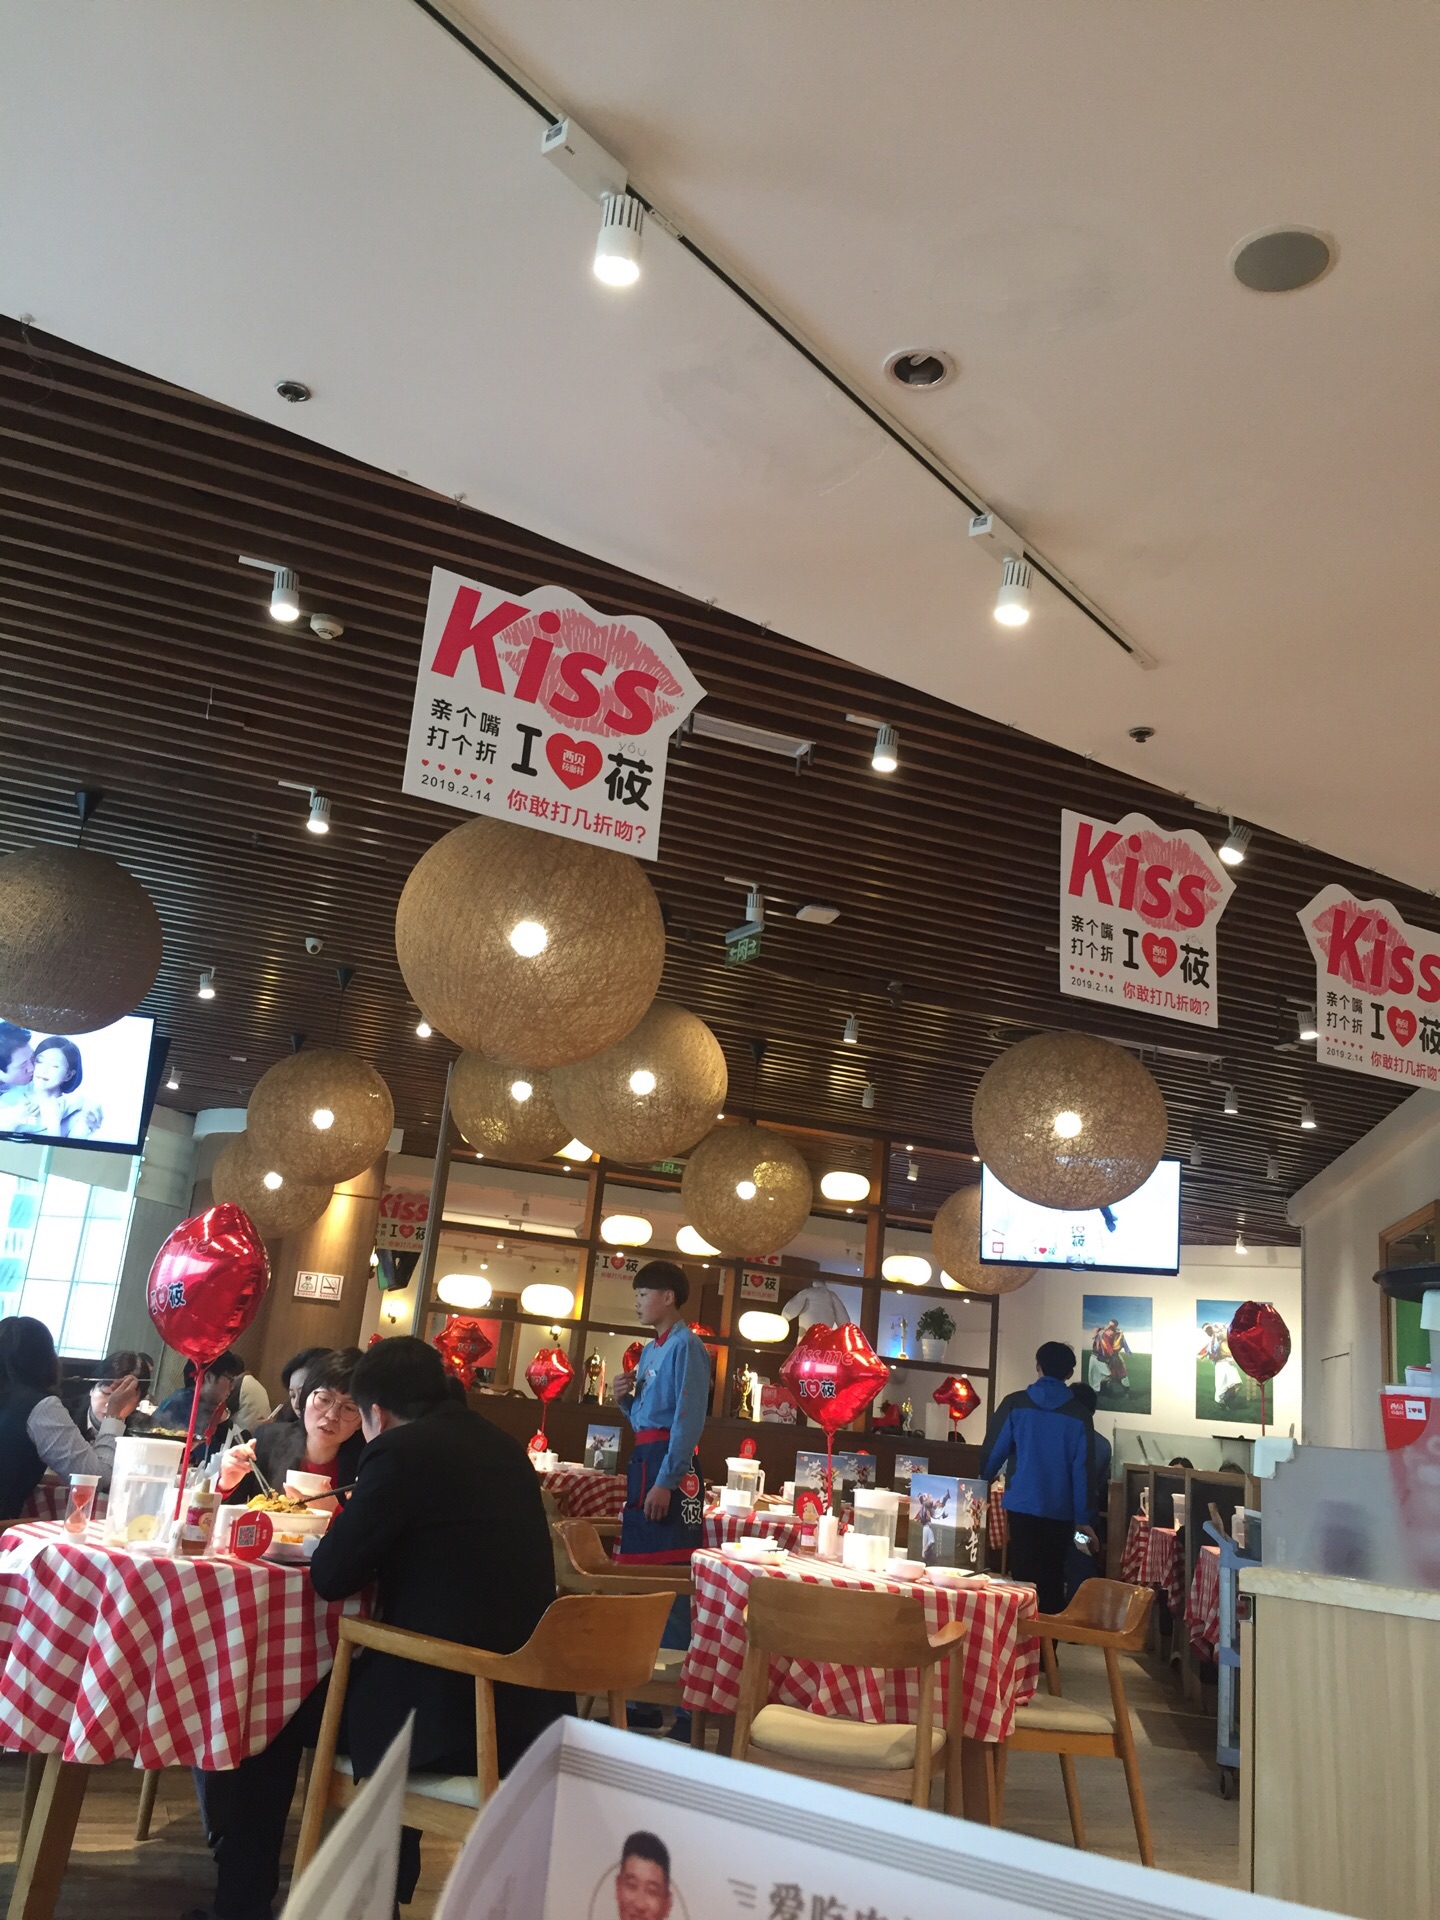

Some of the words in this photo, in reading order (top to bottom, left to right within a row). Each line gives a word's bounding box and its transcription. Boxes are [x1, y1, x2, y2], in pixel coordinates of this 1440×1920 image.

[431, 585, 659, 735] Kiss
[431, 699, 501, 737] 亲个嘴
[427, 726, 497, 764] 打个折
[563, 750, 586, 767] 西贝
[511, 723, 542, 777] I
[604, 753, 654, 811] 莜
[421, 774, 491, 802] 2019.2.14
[507, 789, 646, 843] 你敢打几折吻?
[1068, 822, 1206, 928] Kiss
[1071, 915, 1113, 941] 亲个嘴
[1071, 938, 1113, 963] 打个折
[1122, 928, 1139, 970] I
[1180, 943, 1209, 989] 莜
[1327, 908, 1440, 1003] Kiss
[1071, 977, 1114, 994] 2019.2.14
[1123, 981, 1210, 1016] 你敢打几折吻?
[1327, 991, 1363, 1014] 亲个嘴
[1327, 1012, 1363, 1035] 打个折
[1370, 1002, 1385, 1040] I
[1326, 1047, 1363, 1062] 2019.2.14
[1371, 1051, 1440, 1081] 你敢打几折吻
[681, 1499, 702, 1524] 莜
